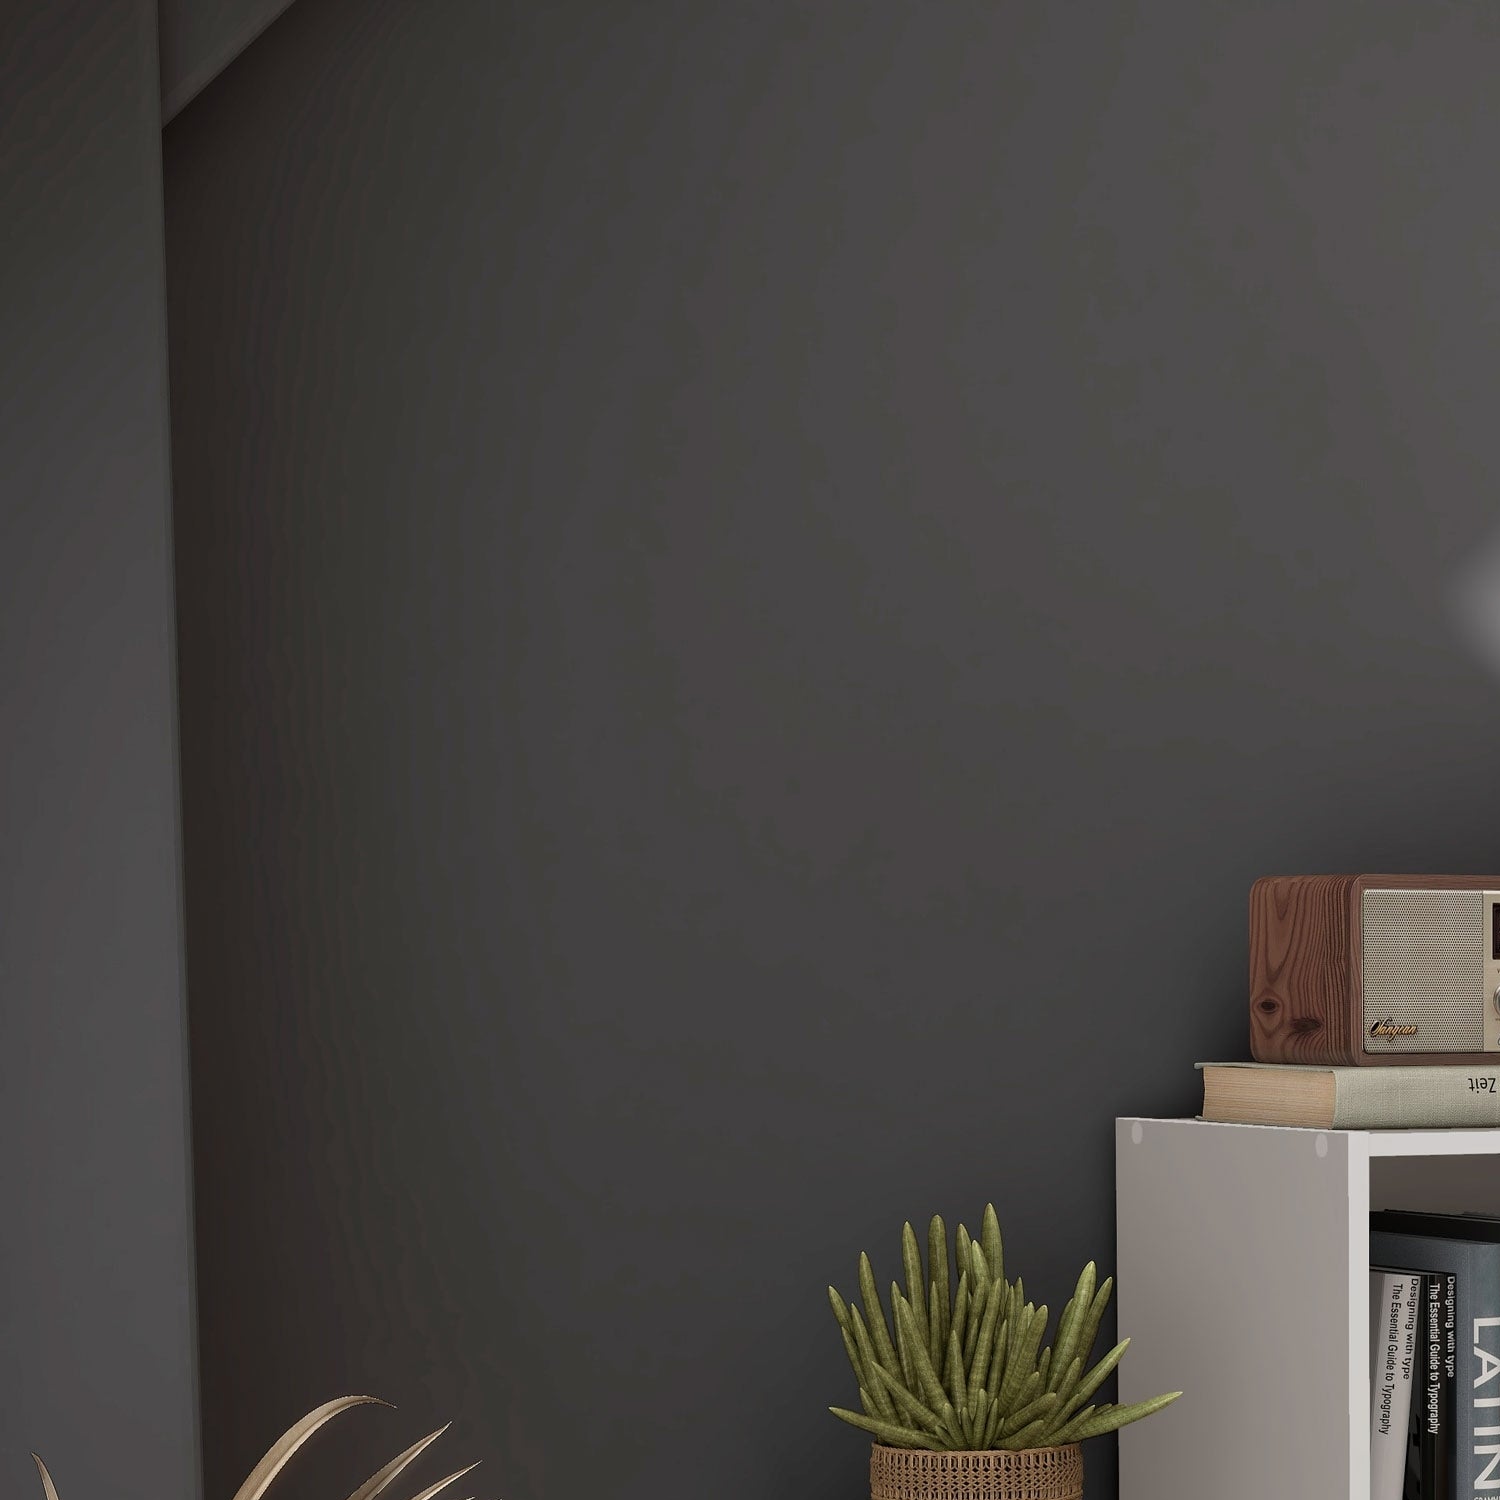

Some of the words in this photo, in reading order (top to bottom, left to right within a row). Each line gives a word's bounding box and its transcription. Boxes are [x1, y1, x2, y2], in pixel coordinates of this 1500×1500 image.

[1468, 1077, 1496, 1093] Zeit
[1392, 1284, 1403, 1299] The
[1430, 1283, 1440, 1300] The
[1445, 1276, 1456, 1328] Designing
[1405, 1278, 1419, 1330] Designing
[1389, 1302, 1401, 1342] Essential
[1430, 1302, 1441, 1342] Essential
[1405, 1332, 1414, 1355] with
[1447, 1330, 1456, 1353] with
[1386, 1344, 1398, 1369] Guide
[1402, 1357, 1412, 1380] type
[1430, 1344, 1441, 1370] Guide
[1445, 1354, 1455, 1378] type
[1385, 1370, 1395, 1381] to
[1430, 1371, 1440, 1381] to
[1379, 1384, 1395, 1435] Typography
[1427, 1382, 1441, 1435] Typography
